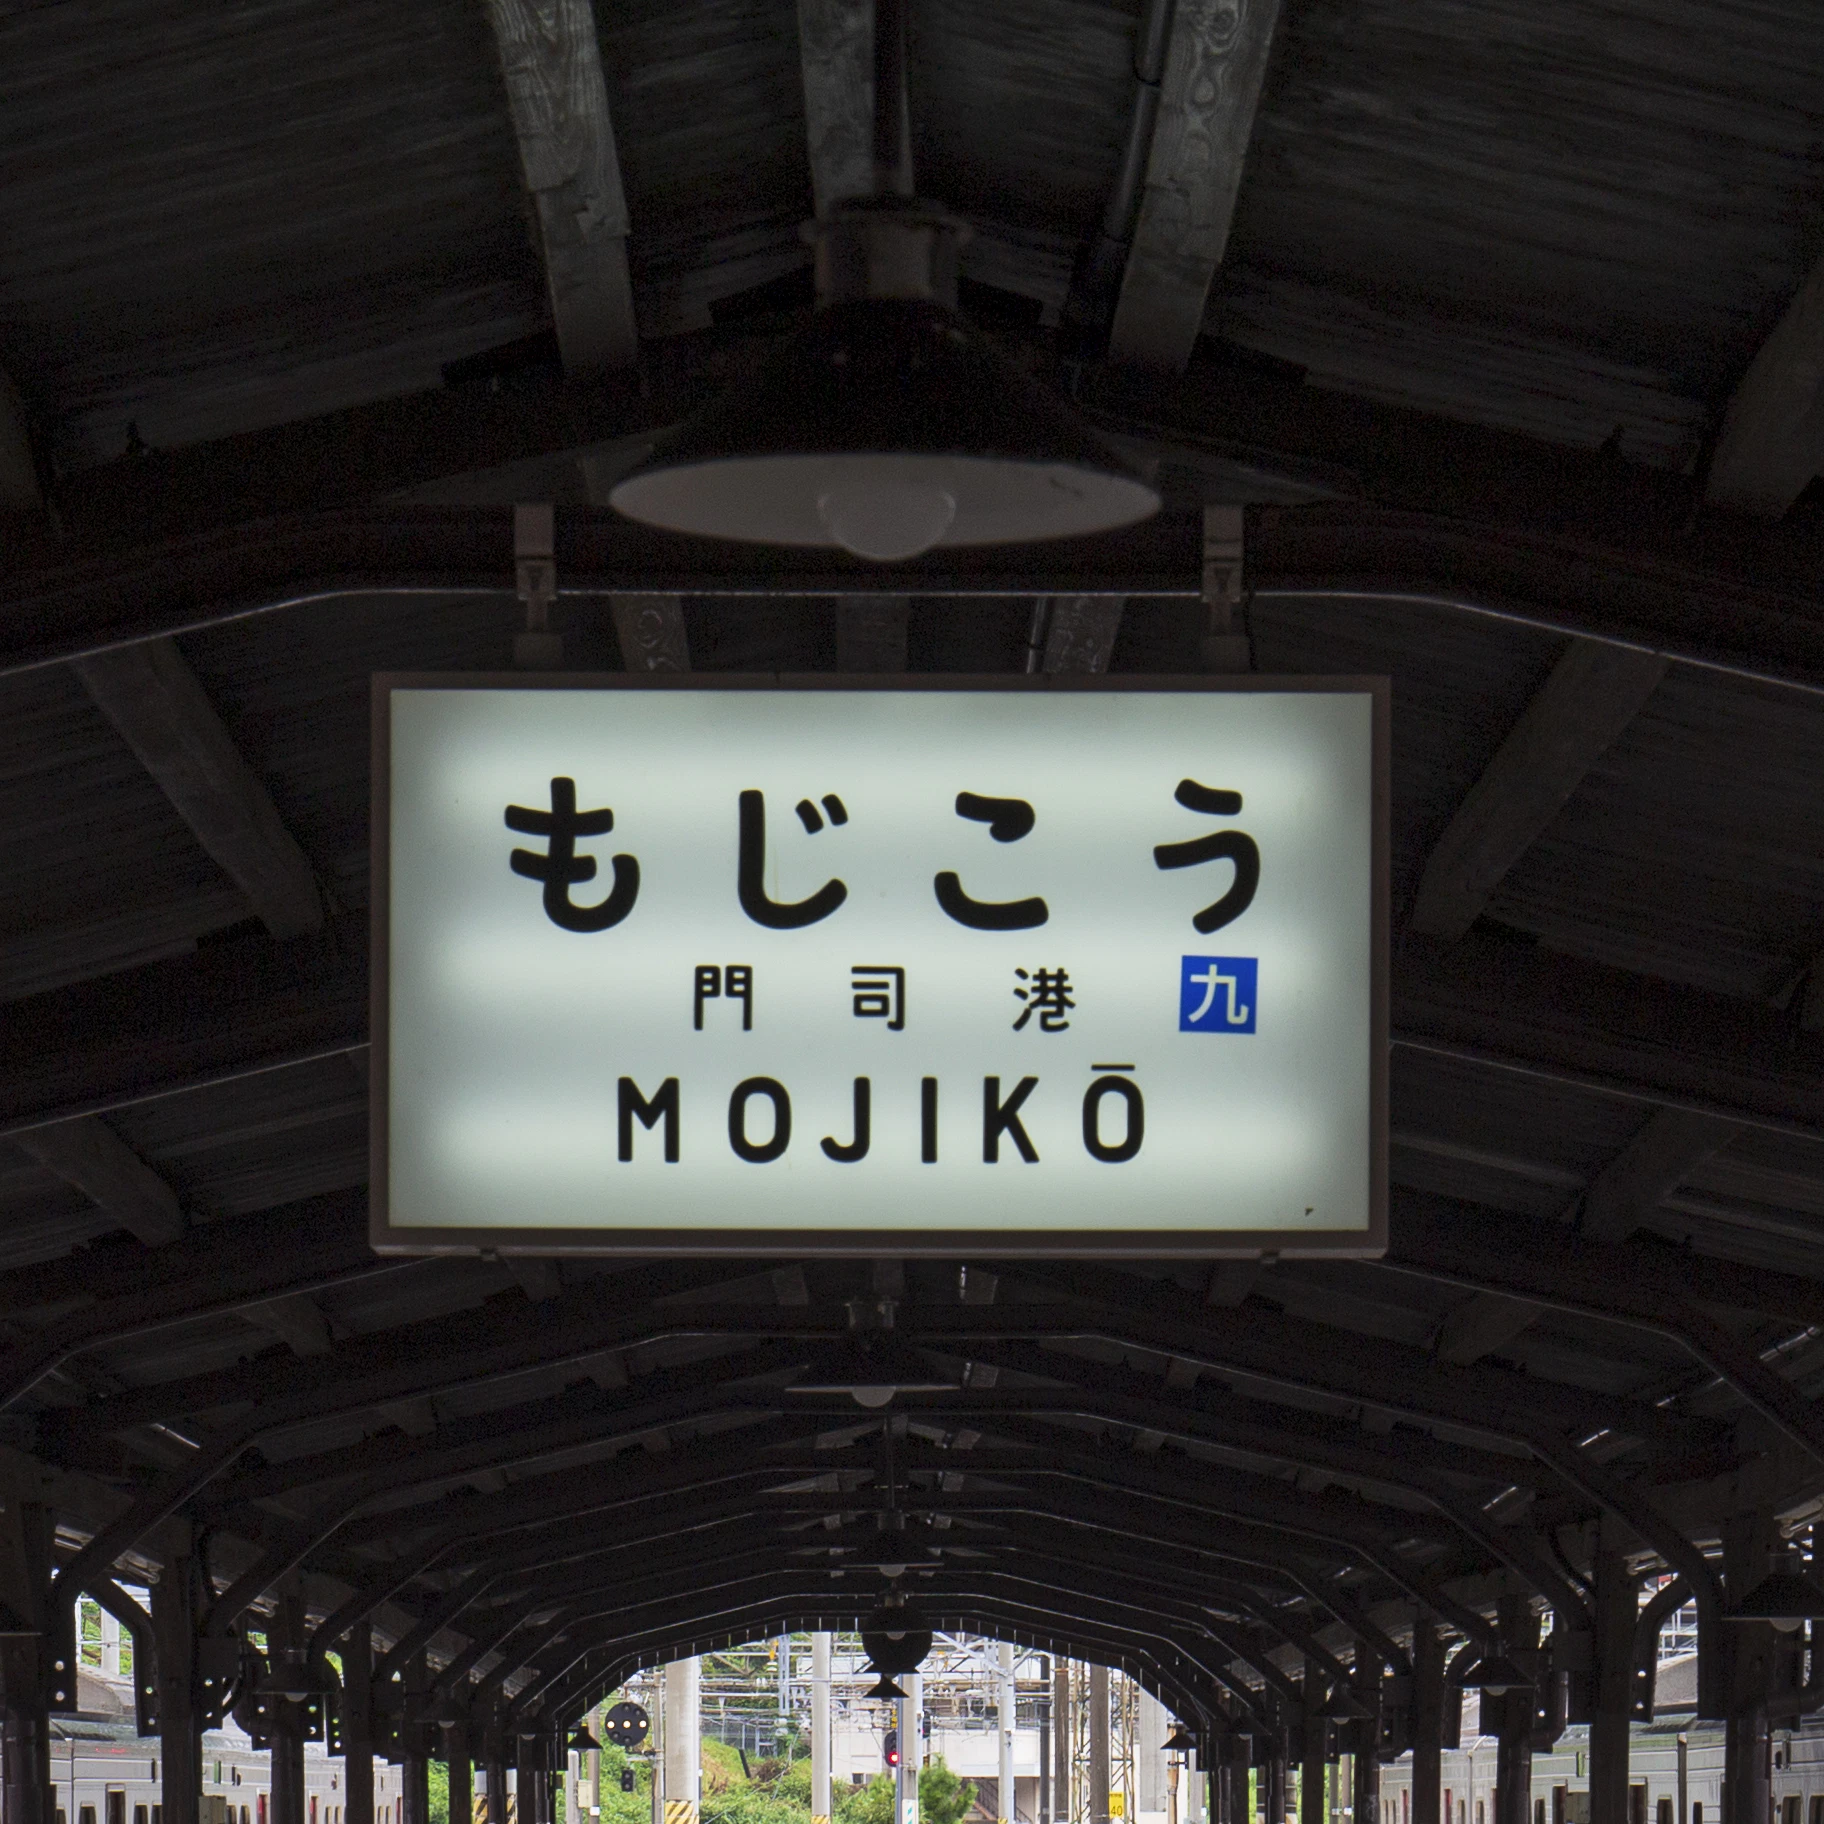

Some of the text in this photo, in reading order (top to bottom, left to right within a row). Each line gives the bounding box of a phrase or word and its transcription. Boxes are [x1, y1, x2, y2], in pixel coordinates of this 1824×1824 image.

[504, 775, 1260, 935] もじこう
[693, 965, 1077, 1032] 門司港
[1188, 963, 1251, 1027] 九
